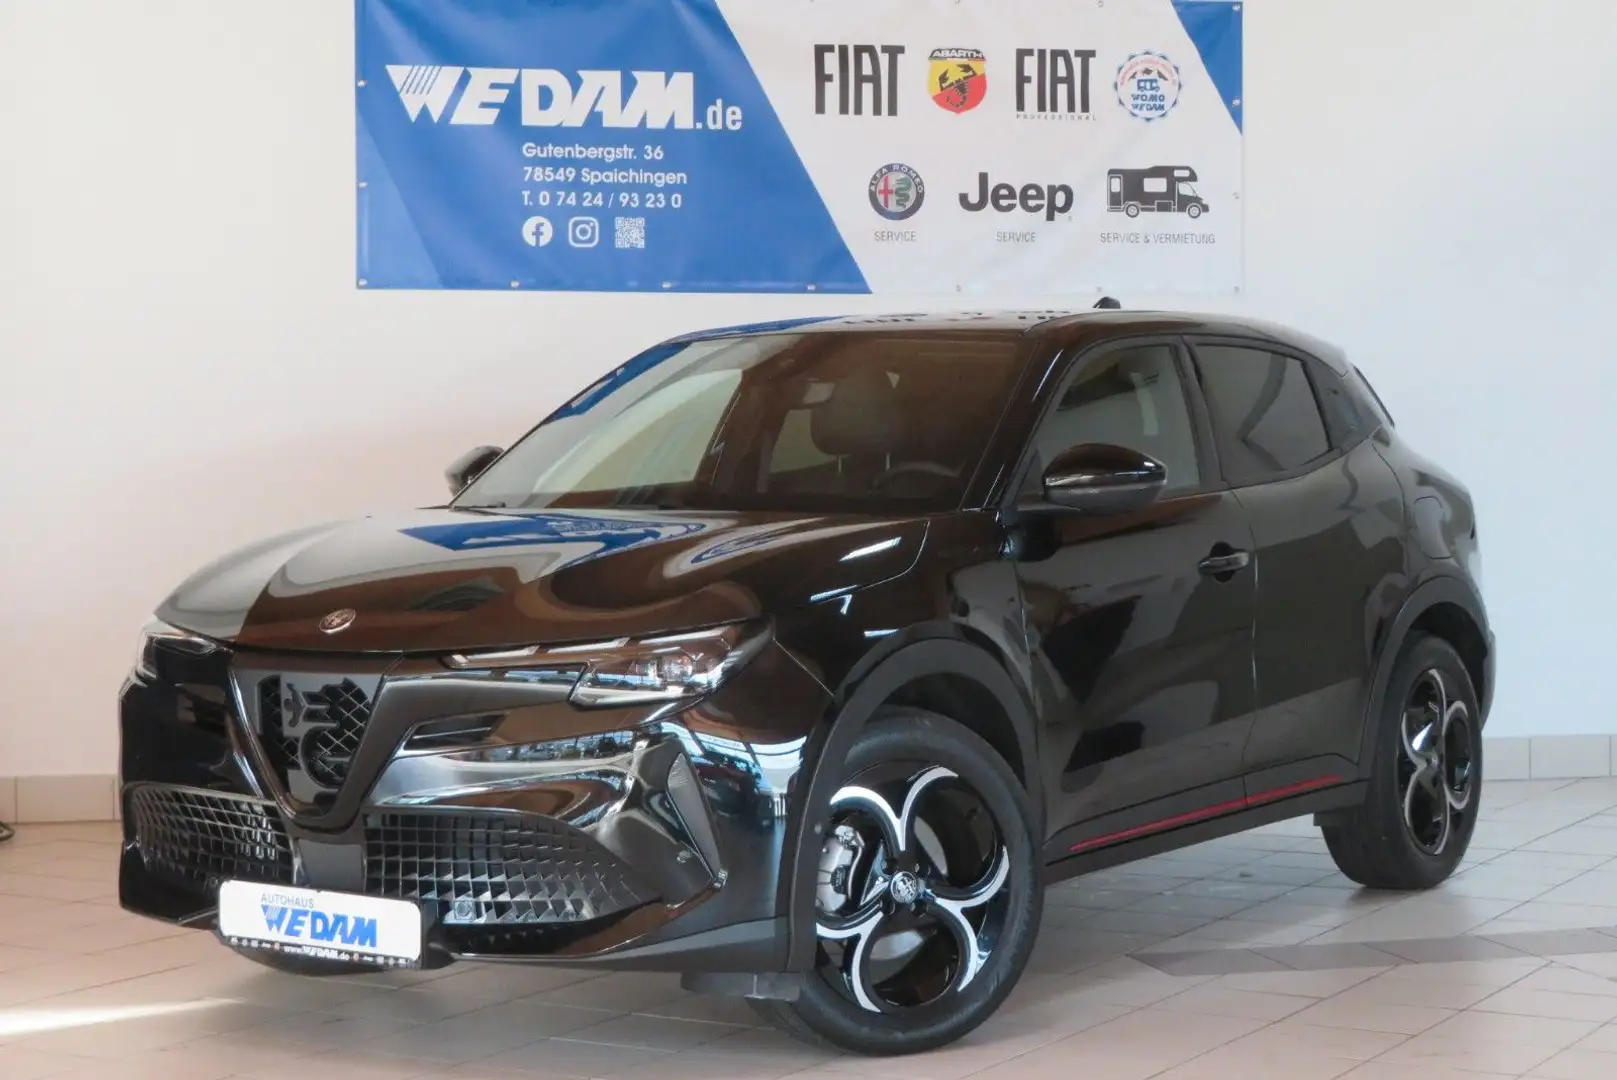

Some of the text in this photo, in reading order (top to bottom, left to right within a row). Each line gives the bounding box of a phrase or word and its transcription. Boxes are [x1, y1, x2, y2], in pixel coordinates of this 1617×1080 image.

[931, 48, 984, 59] ABARTH
[813, 44, 905, 116] FIAT
[1015, 48, 1096, 114] FIAT
[1131, 93, 1165, 102] WOMO
[522, 142, 664, 163] Gutenbergstr. 36
[523, 166, 687, 187] 78549 Spaichingen
[870, 164, 924, 193] ALFA ROMEO
[522, 191, 533, 206] T.
[539, 192, 550, 206] 0
[556, 192, 577, 207] 74
[582, 192, 604, 207] 24
[619, 192, 640, 208] 93
[645, 193, 666, 208] 23
[671, 194, 682, 208] 0
[958, 172, 1074, 222] Jeep
[874, 230, 916, 242] SERVICE
[996, 231, 1036, 243] SERVICE
[1100, 232, 1216, 244] SERVICE & VERMIETUNG
[261, 893, 314, 908] AUTOHAUS
[261, 904, 377, 947] WEDAM
